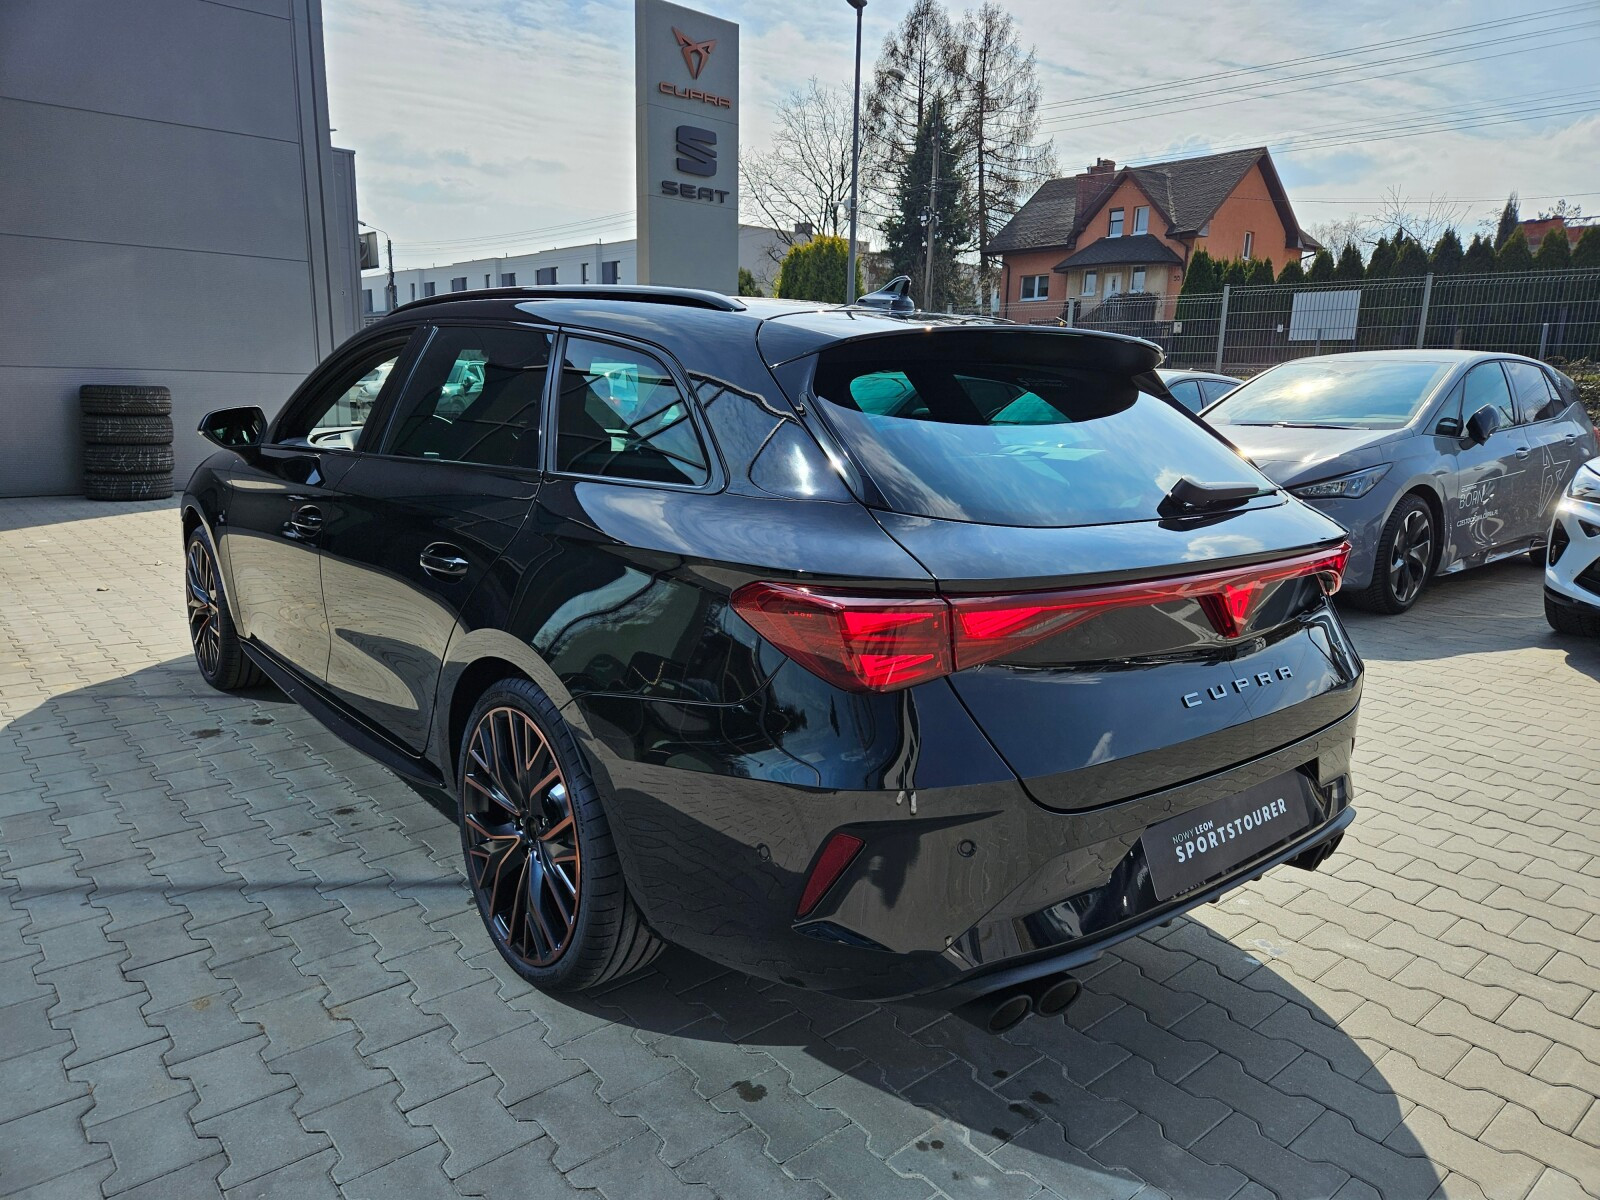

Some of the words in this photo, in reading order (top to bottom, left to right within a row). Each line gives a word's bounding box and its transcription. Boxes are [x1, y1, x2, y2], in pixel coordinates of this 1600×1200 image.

[659, 81, 732, 109] CUPRA
[661, 180, 730, 204] SEAT
[1459, 488, 1485, 509] BORN
[1181, 665, 1294, 708] CUPRA
[1172, 828, 1195, 845] NOWY
[1195, 820, 1214, 834] LEON
[1175, 798, 1288, 863] SPORTSTOURER
